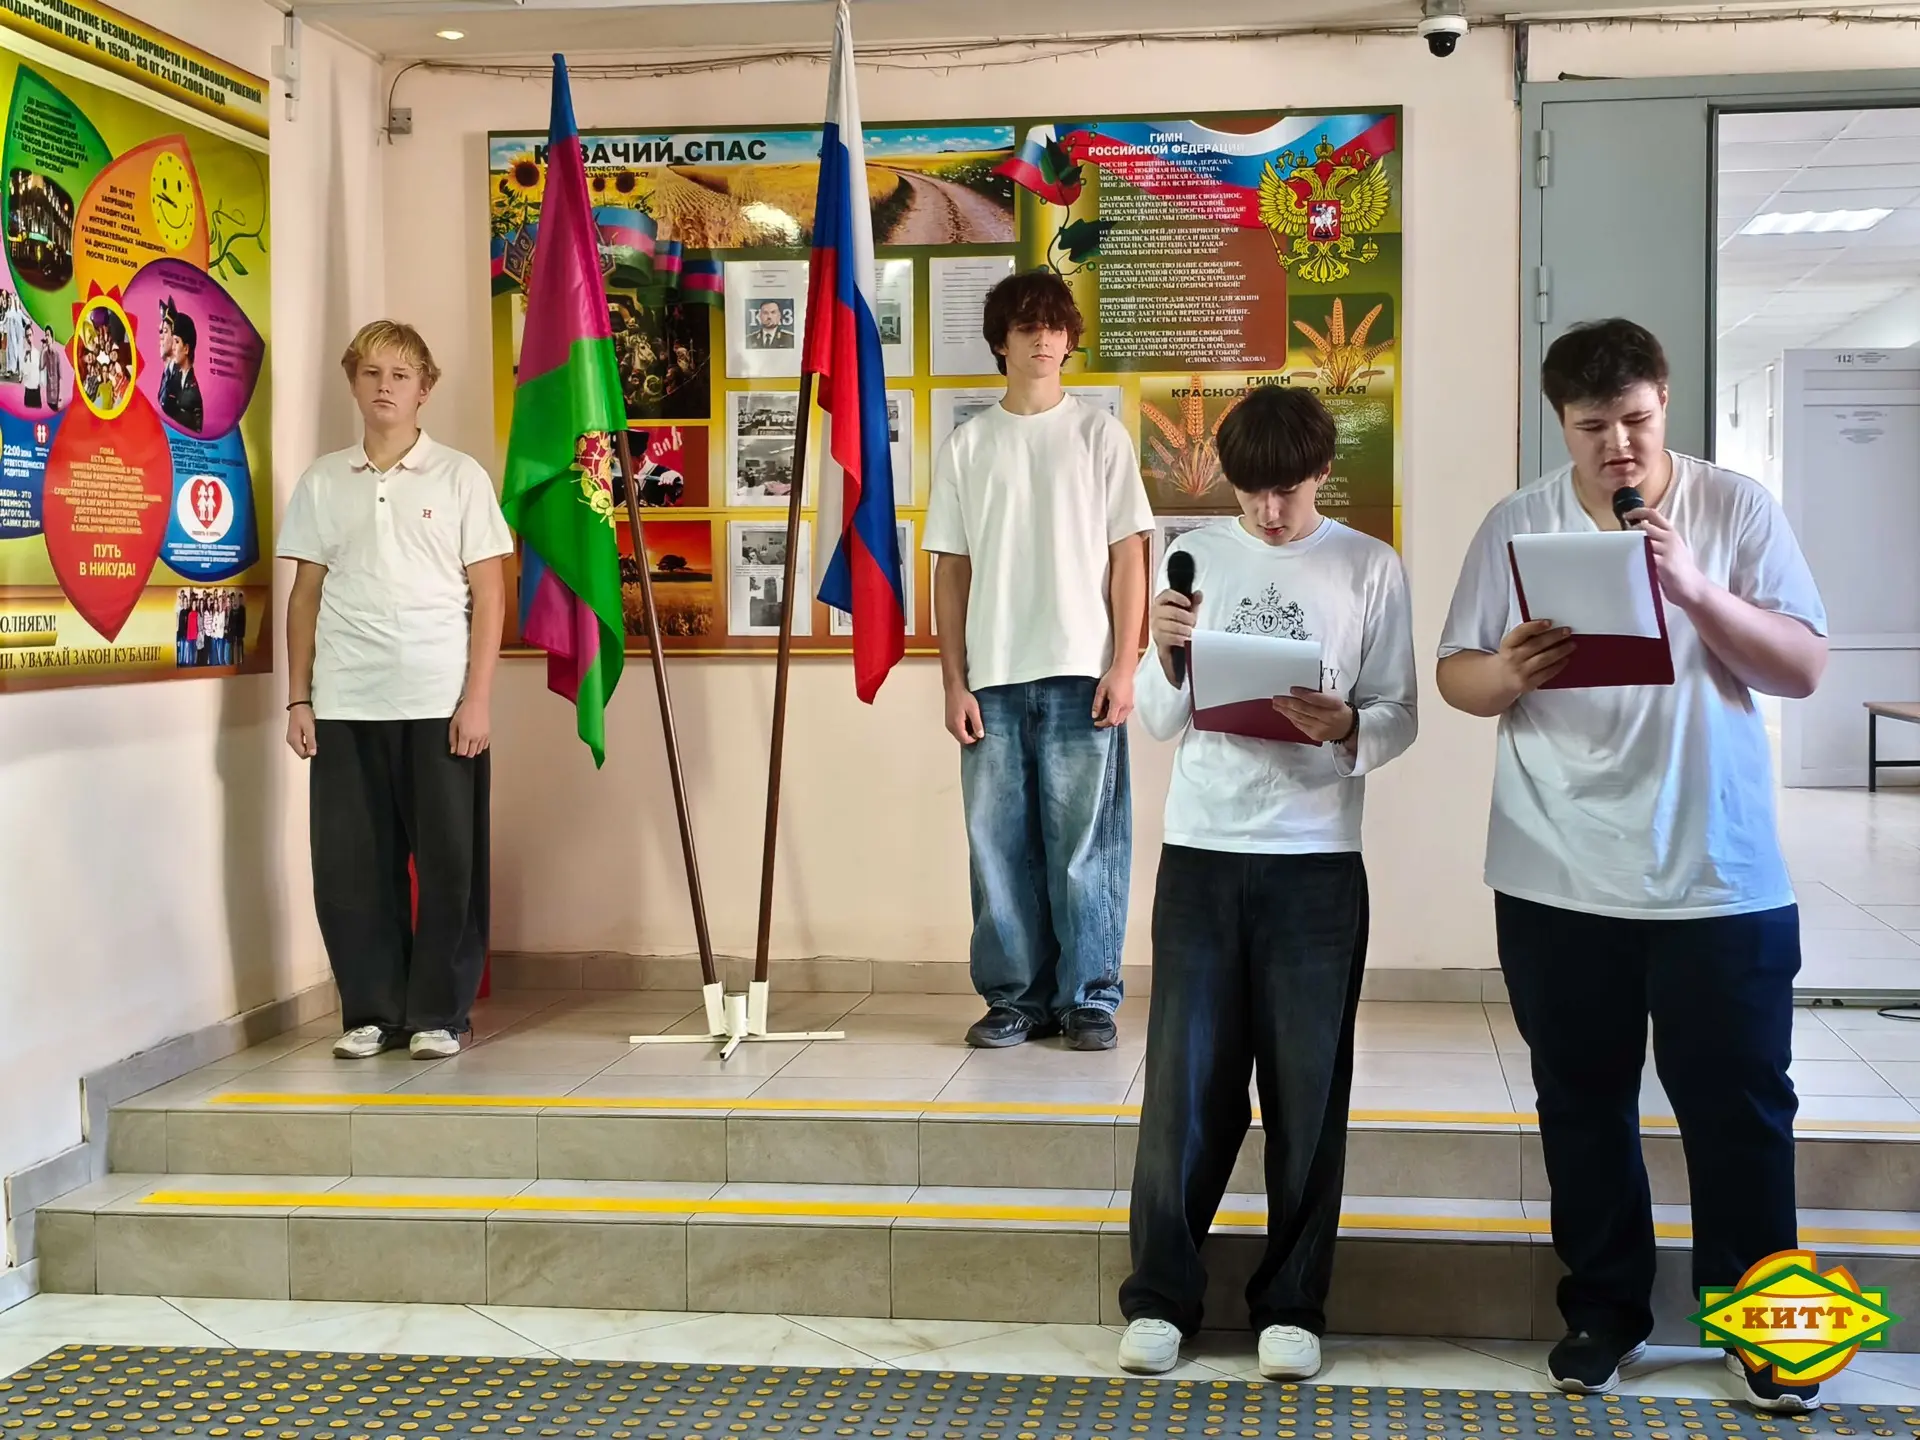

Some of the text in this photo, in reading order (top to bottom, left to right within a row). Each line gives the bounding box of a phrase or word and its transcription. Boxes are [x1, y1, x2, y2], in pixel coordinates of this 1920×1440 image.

[34, 0, 261, 104] ФИЛАКТИКЕ БЕЗНАДЗОРНОСТИ И ПРАВОНАРУШЕНИЙ
[107, 41, 130, 62] 1539
[149, 60, 160, 75] ОТ
[205, 86, 225, 106] ГОДА
[1150, 132, 1183, 142] ГИМН
[534, 136, 767, 165] КЗАЧИЙ СПАС
[1088, 142, 1245, 156] РОССИЙСКОЙ ФЕДЕРАЦИИ
[749, 308, 793, 326] КЗ
[1837, 355, 1852, 363] 112
[1246, 375, 1291, 386] ГИМН
[1171, 385, 1367, 398] КРАСНОДО КРАЯ
[94, 544, 121, 558] ПУТЬ
[79, 562, 136, 578] В НИКУДА!
[0, 615, 56, 632] ОЛНЯЕМ!
[20, 647, 70, 669] УВАЖАЙ
[73, 650, 111, 665] ЗАКОН
[114, 646, 162, 661] КУБАНИ!
